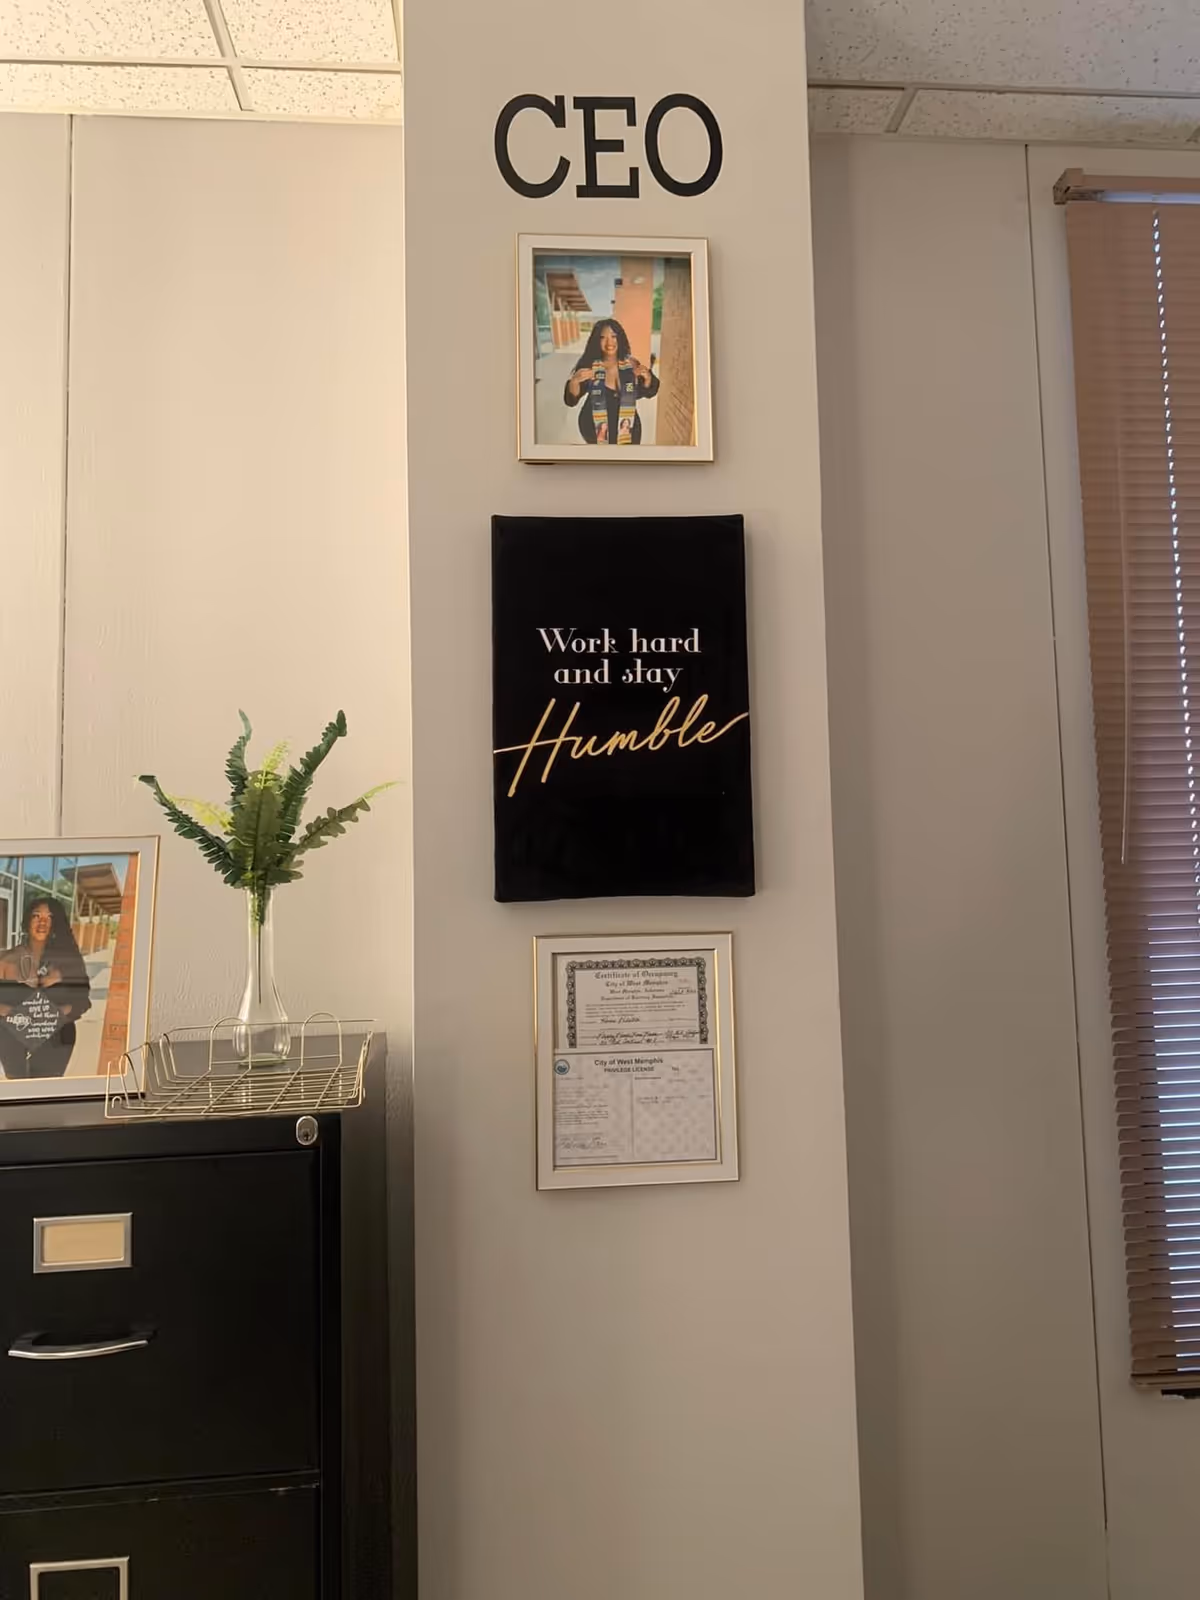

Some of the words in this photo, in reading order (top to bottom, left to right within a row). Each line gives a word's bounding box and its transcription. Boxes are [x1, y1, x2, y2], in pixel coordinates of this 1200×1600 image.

[494, 93, 723, 199] CEO
[536, 628, 619, 653] Work
[628, 628, 702, 653] hard
[553, 659, 612, 684] and
[621, 658, 684, 693] stay
[493, 694, 749, 797] Humble
[594, 1059, 608, 1067] City
[634, 1058, 663, 1066] Memphis
